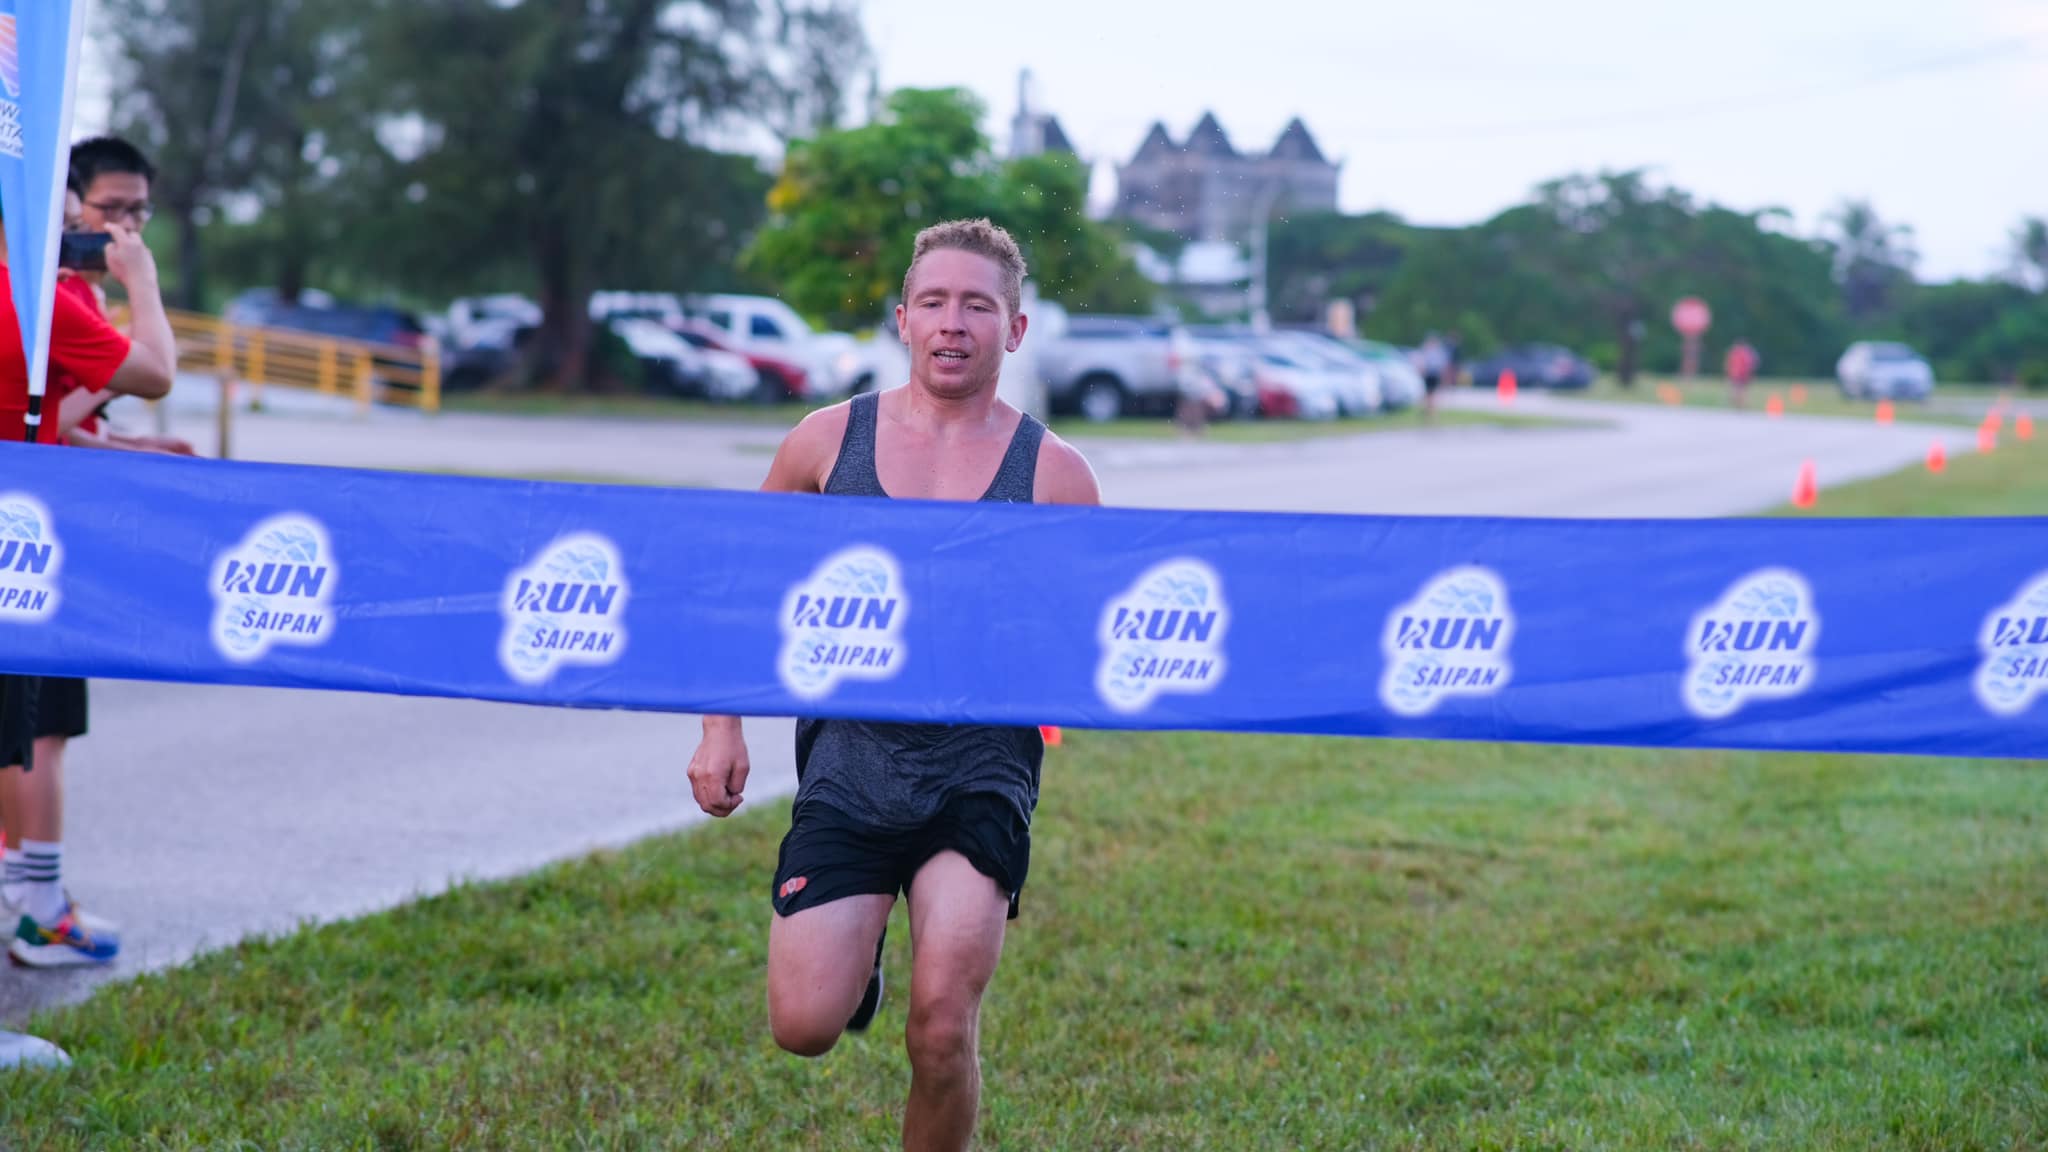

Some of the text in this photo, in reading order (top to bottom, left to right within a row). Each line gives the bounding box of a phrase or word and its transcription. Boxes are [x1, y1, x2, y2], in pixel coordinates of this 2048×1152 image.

[0, 540, 52, 575] UN
[222, 560, 327, 598] RUN
[0, 586, 48, 611] IPAN
[513, 579, 618, 615] RUN
[242, 609, 322, 634] SAIPAN
[792, 595, 897, 630] RUN
[1112, 608, 1217, 642] RUN
[531, 628, 614, 652] SAIPAN
[1397, 617, 1503, 650] RUN
[1699, 620, 1807, 652] RUN
[1993, 617, 2048, 647] RU
[810, 645, 893, 667] SAIPAN
[1128, 657, 1213, 679] SAIPAN
[2008, 656, 2048, 678] SAI
[1412, 667, 1499, 686] SAIPAN
[1715, 664, 1803, 685] SAIPAN
